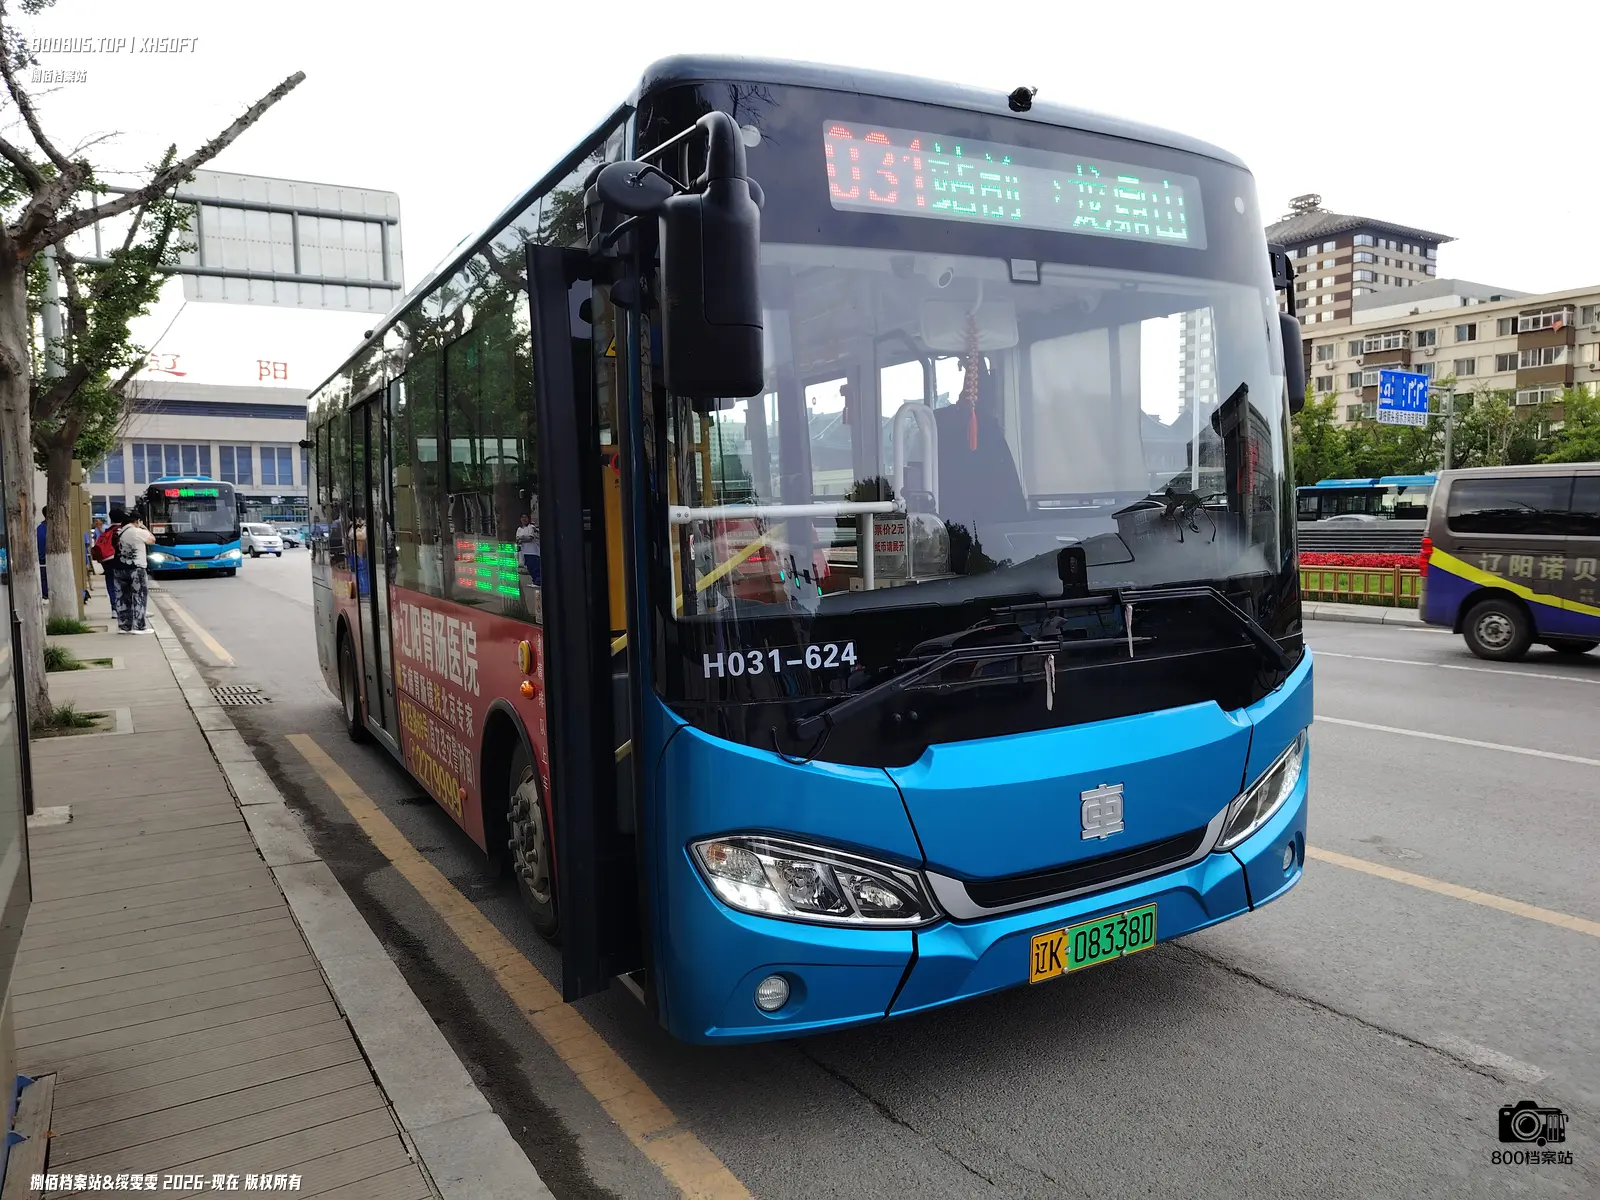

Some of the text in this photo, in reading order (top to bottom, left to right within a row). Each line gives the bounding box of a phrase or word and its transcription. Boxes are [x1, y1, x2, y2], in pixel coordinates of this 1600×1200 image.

[824, 124, 925, 208] 031
[874, 523, 905, 536] 票价2元
[874, 540, 905, 552] 纸币请展开
[1478, 553, 1598, 582] 辽阳诺贝
[400, 600, 480, 698] 辽阳胃肠医院
[703, 642, 857, 679] H031-624
[1074, 911, 1154, 964] 08338D
